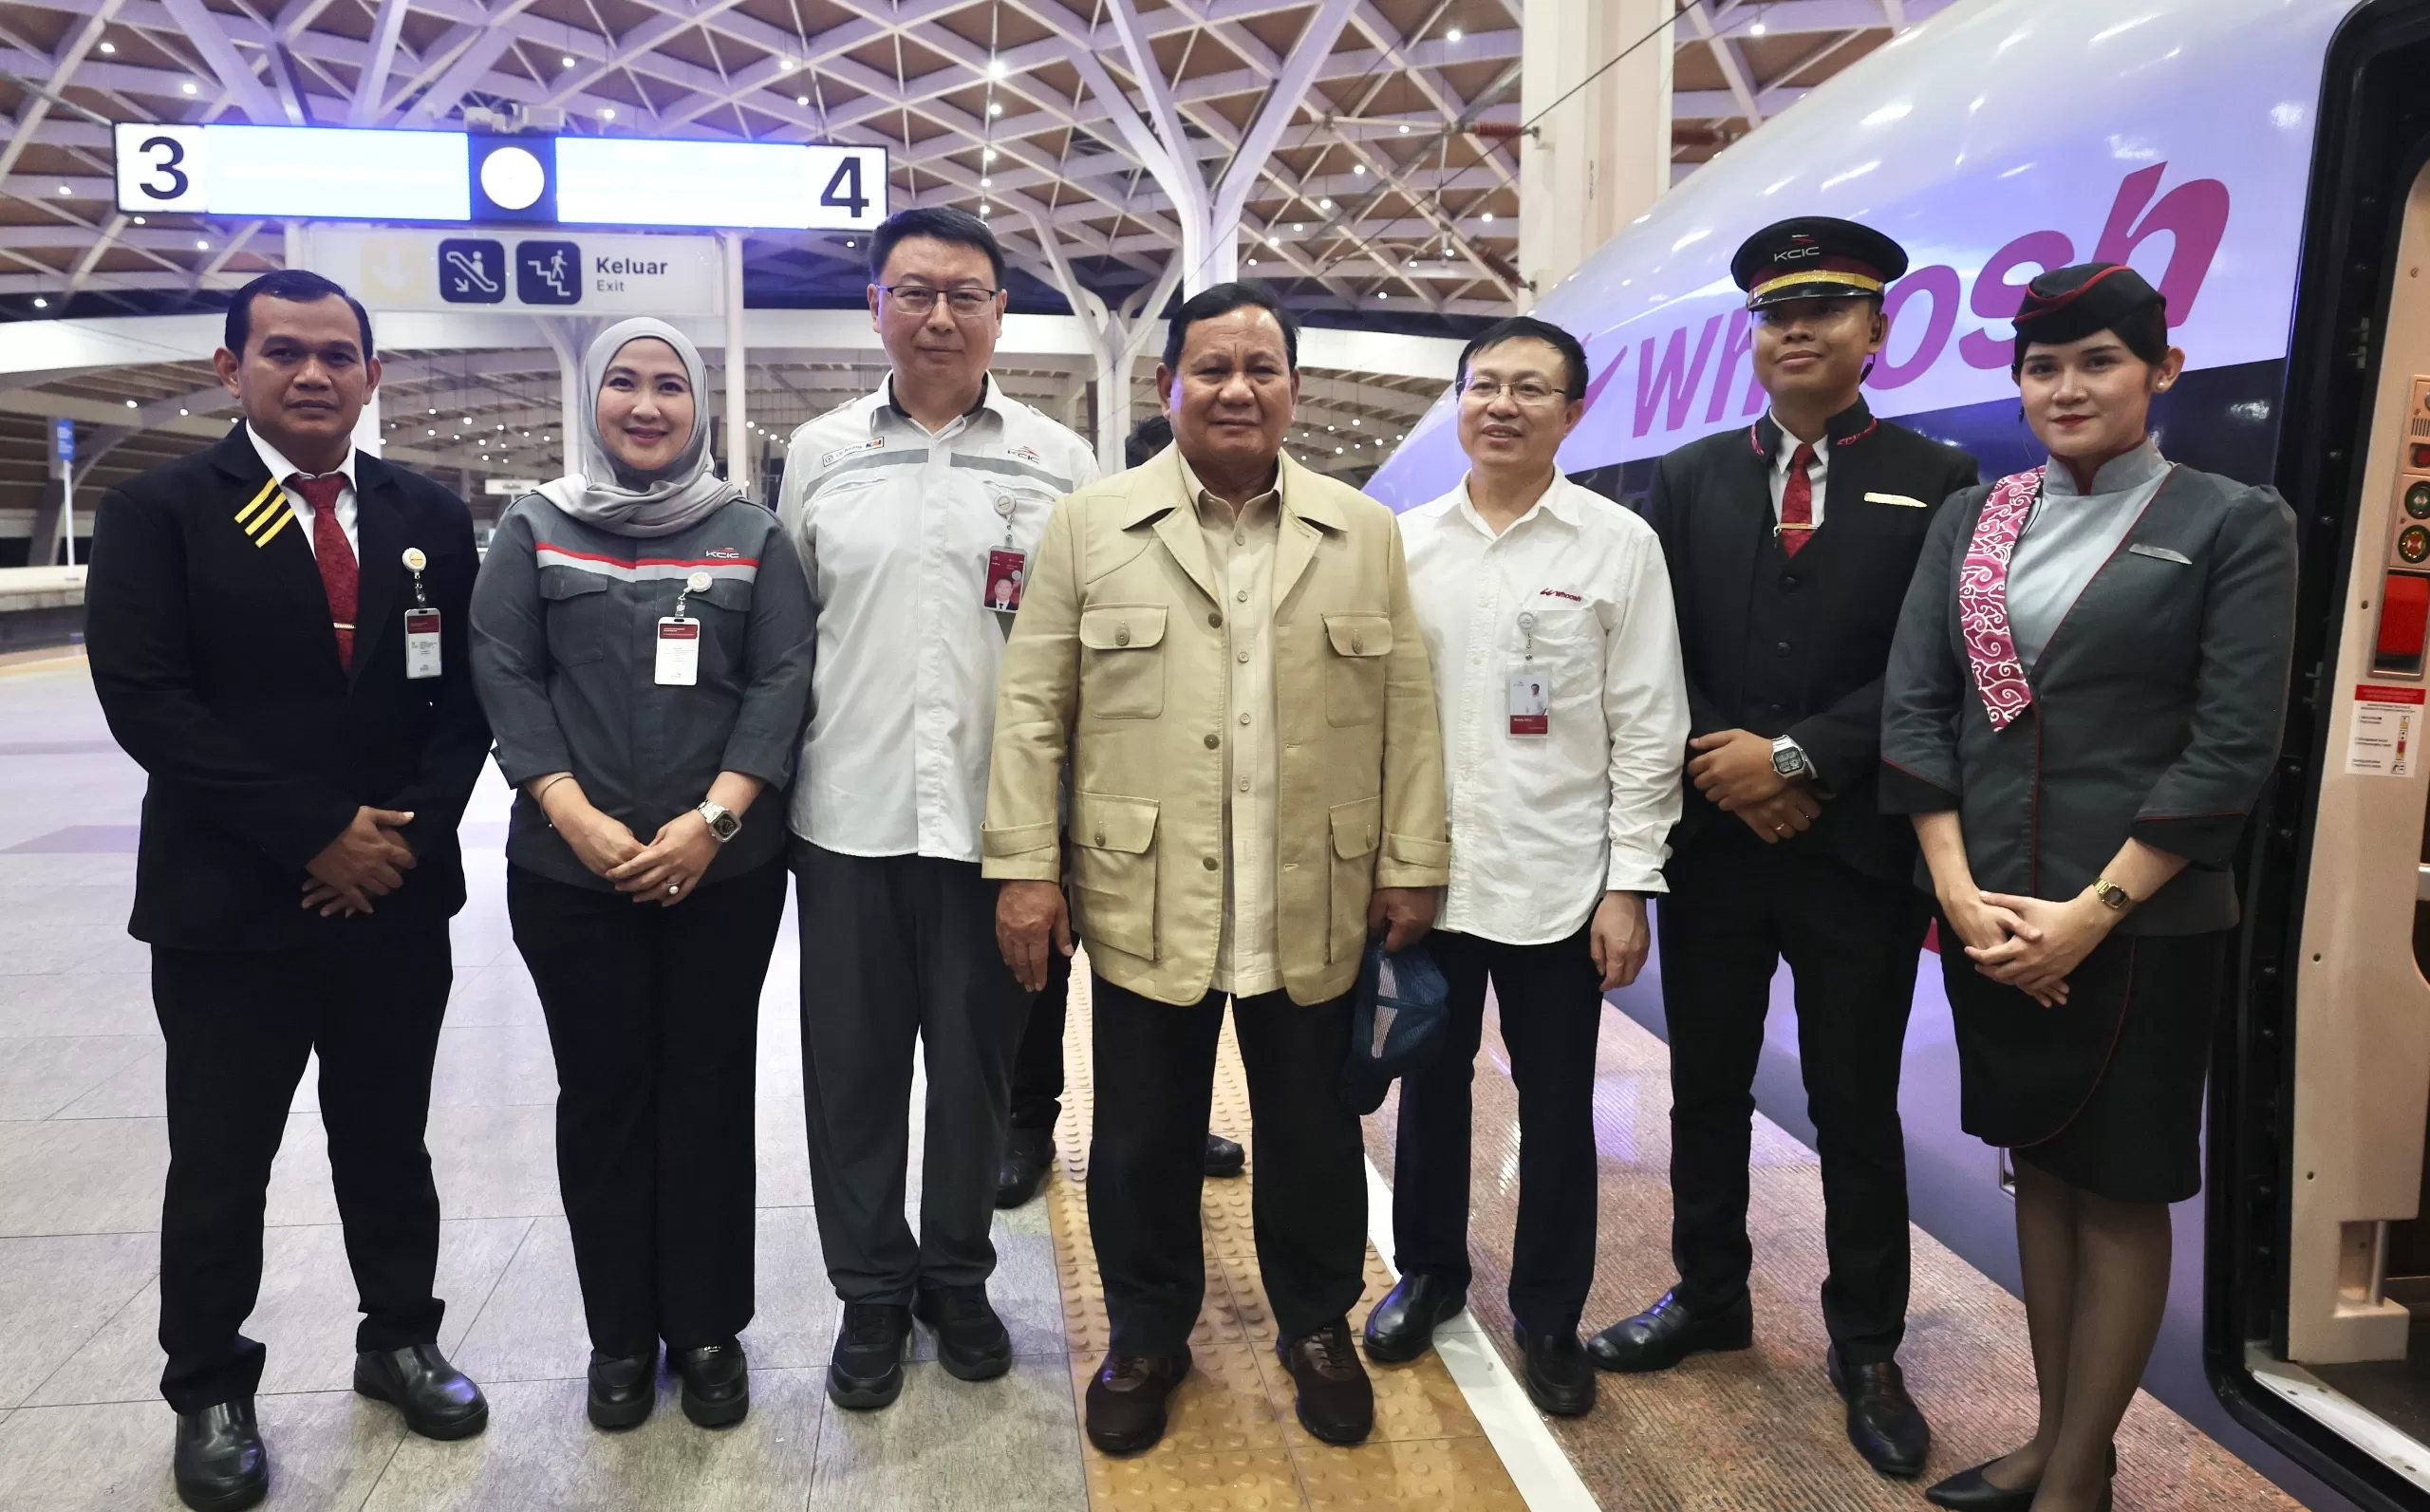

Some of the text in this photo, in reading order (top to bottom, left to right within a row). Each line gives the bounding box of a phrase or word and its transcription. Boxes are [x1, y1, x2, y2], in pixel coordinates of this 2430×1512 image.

[139, 136, 190, 200] 3
[821, 157, 870, 218] 4
[1774, 247, 1820, 262] KCIC
[596, 256, 668, 274] Keluar
[596, 279, 625, 291] Exit
[1633, 160, 2230, 438] whosh
[1007, 450, 1040, 464] KCIC
[705, 551, 740, 559] KCIC
